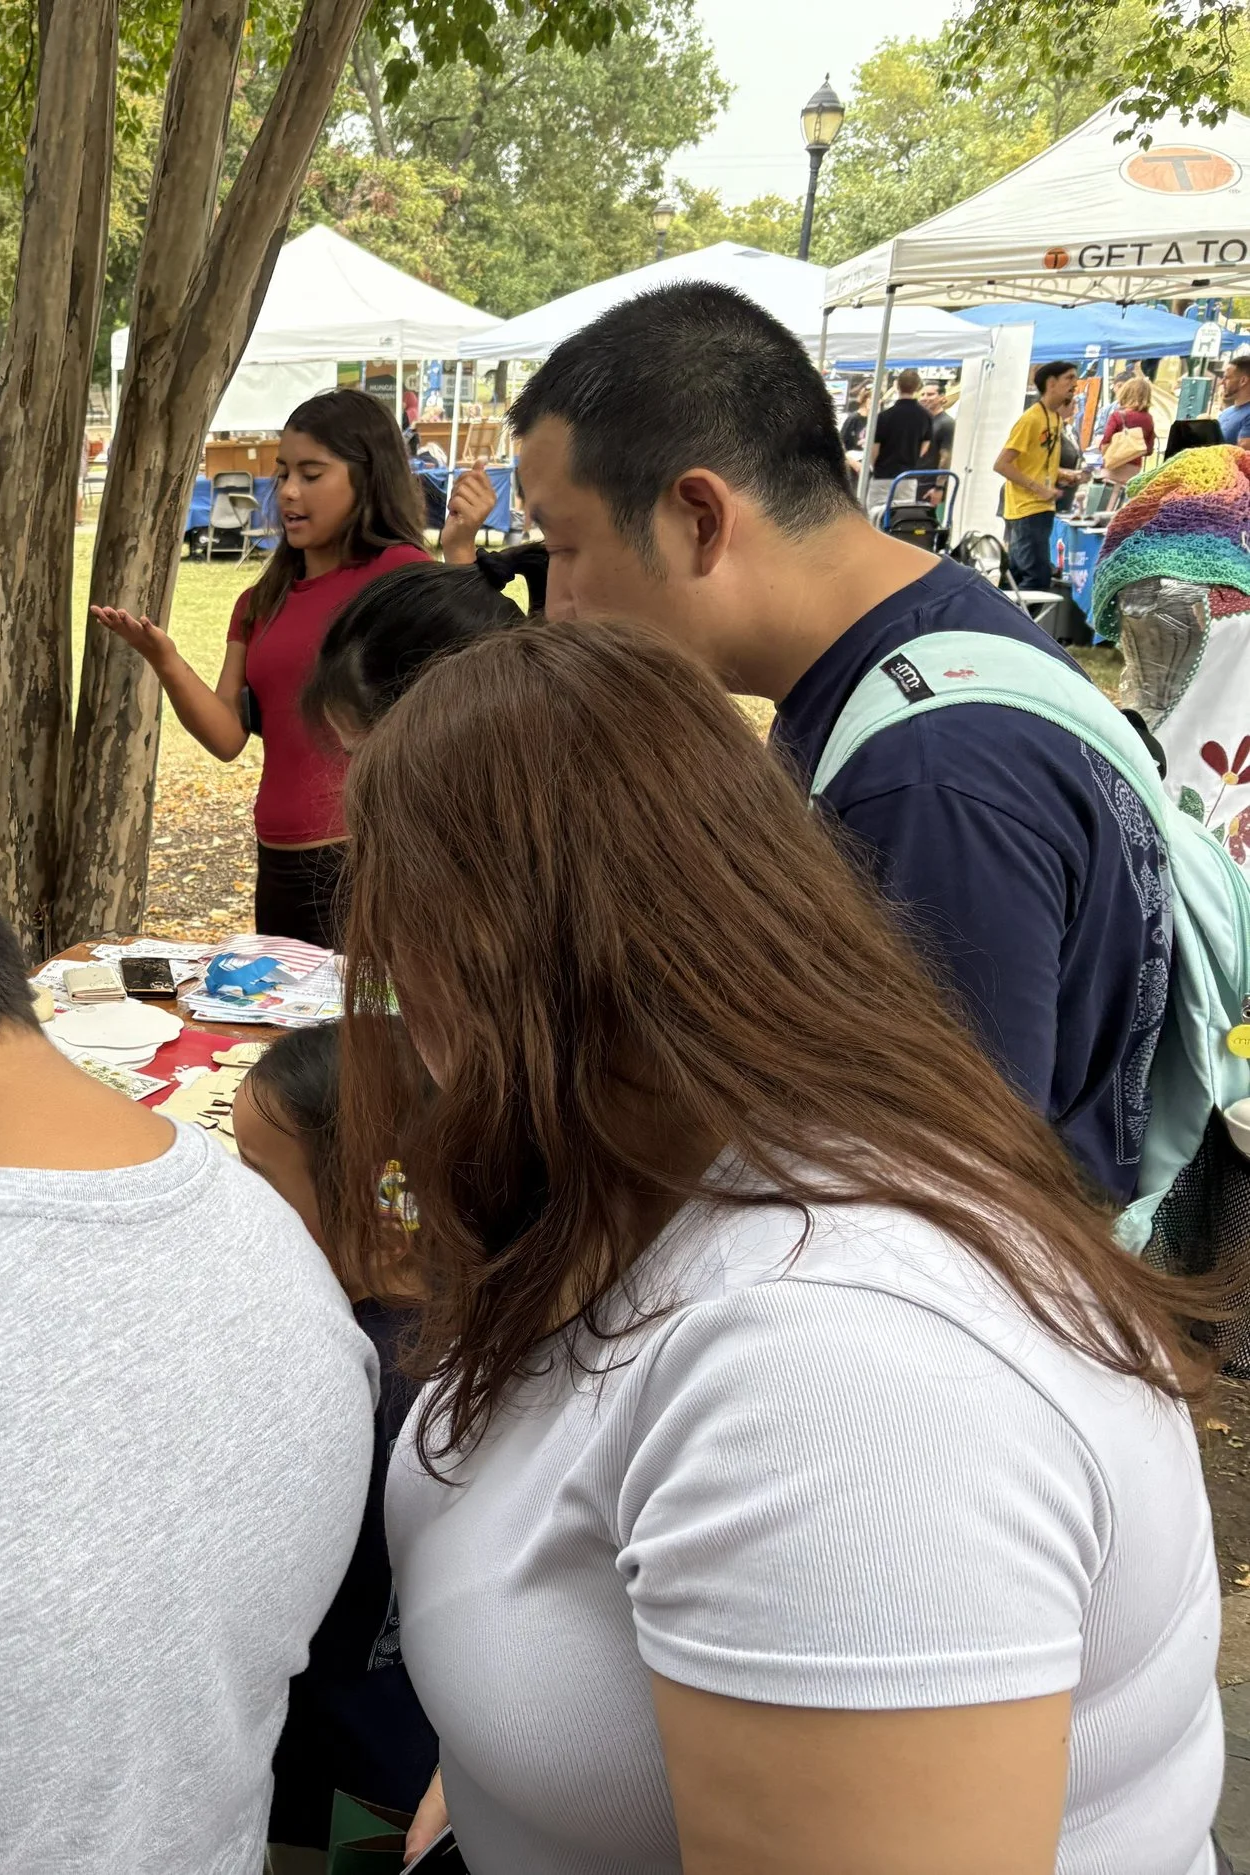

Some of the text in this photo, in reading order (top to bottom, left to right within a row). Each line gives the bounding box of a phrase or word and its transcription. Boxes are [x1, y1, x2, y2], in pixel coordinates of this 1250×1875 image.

[1142, 154, 1212, 191] T
[1078, 243, 1153, 269] GET
[1161, 241, 1185, 265] A
